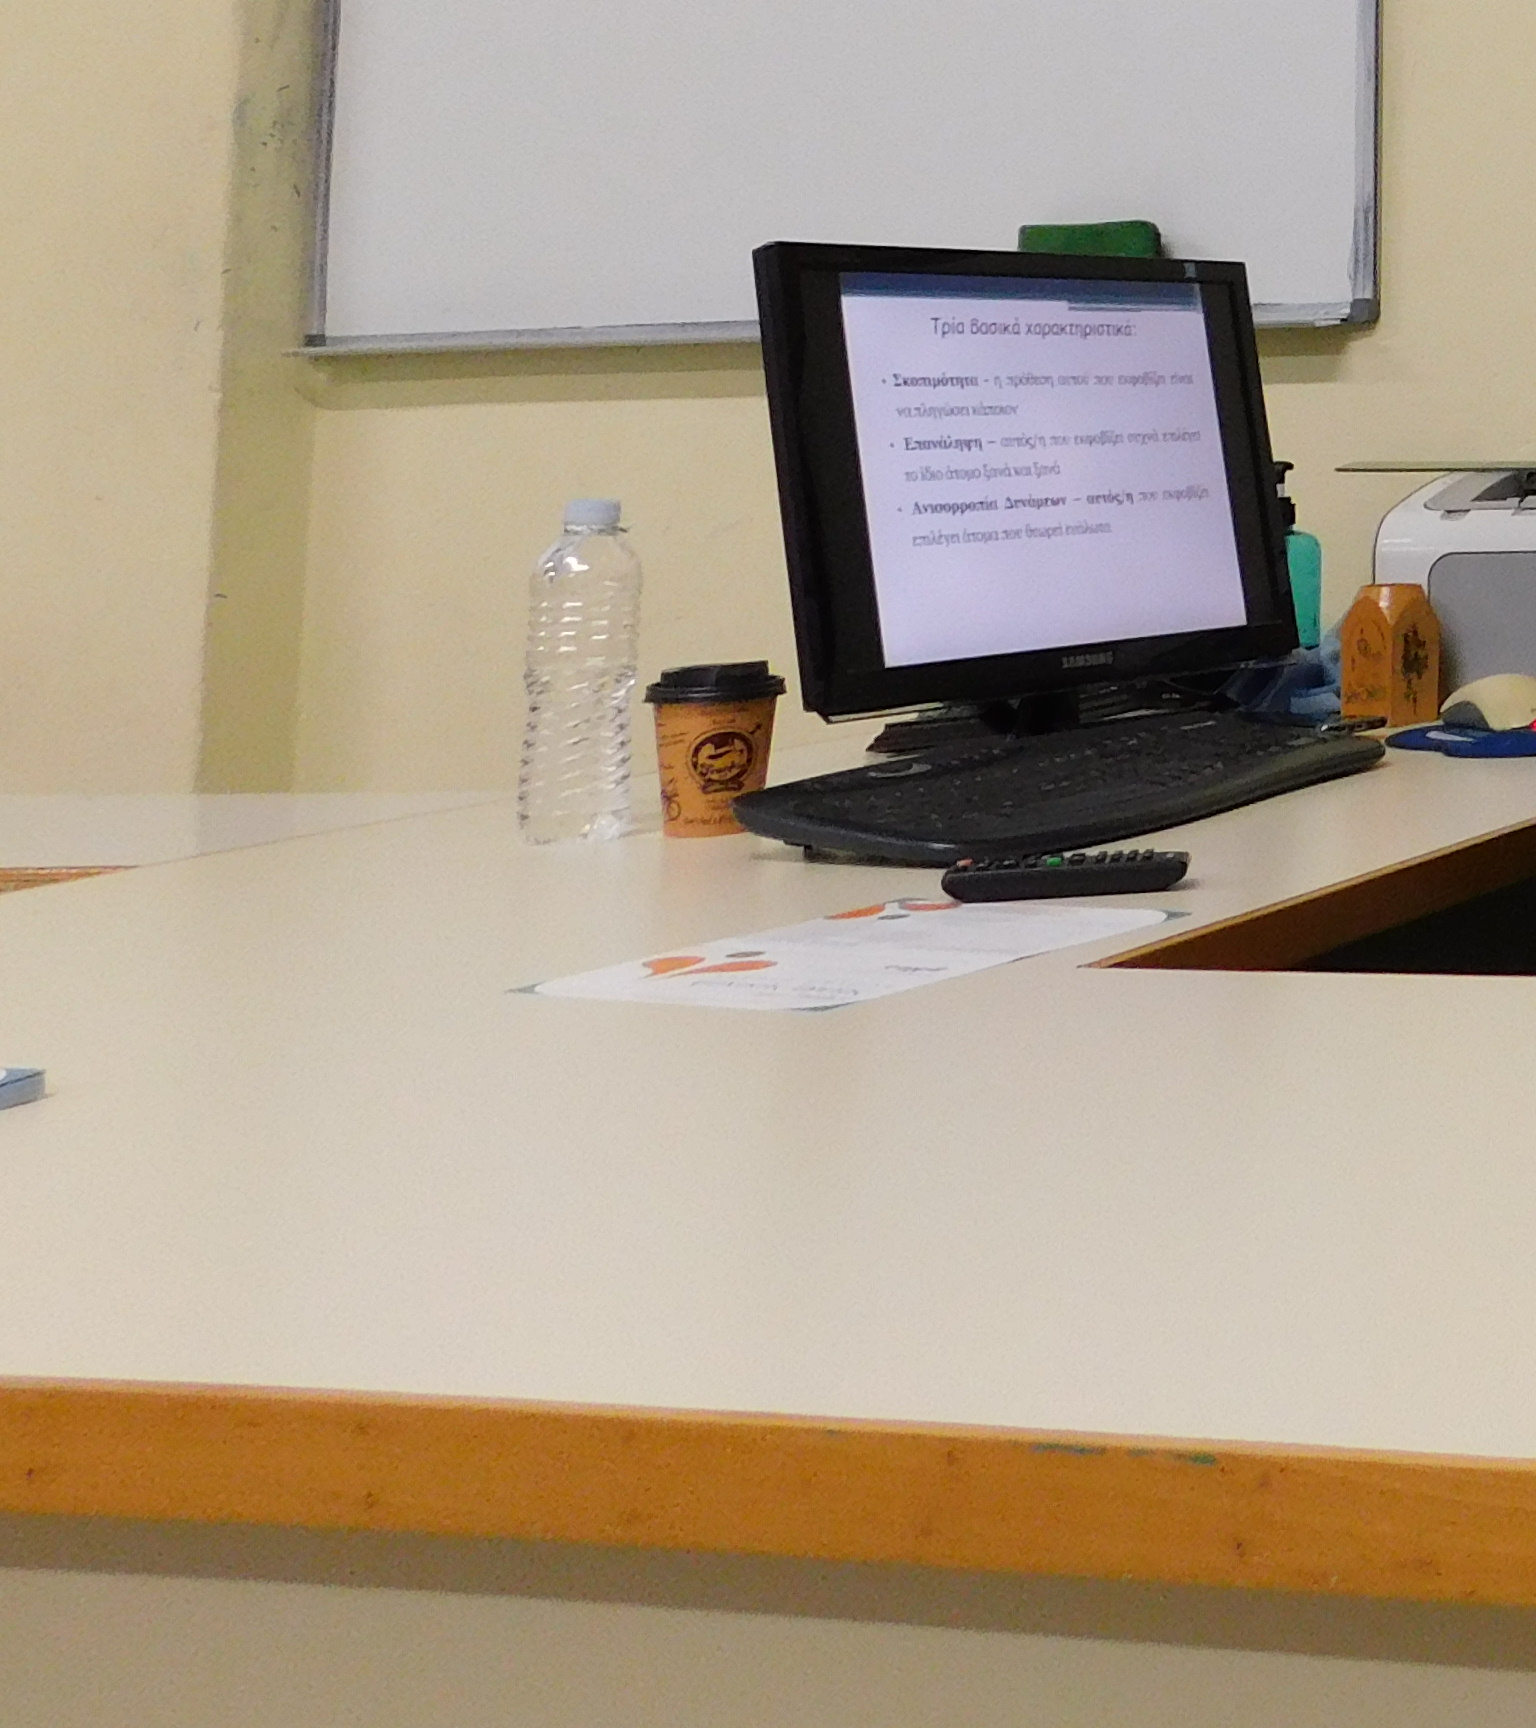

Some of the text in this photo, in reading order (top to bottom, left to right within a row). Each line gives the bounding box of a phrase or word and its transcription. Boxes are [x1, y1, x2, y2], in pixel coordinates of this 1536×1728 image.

[930, 316, 965, 338] Τρία
[970, 317, 1021, 336] βασικά
[892, 372, 980, 390] Σκοπιμότητα
